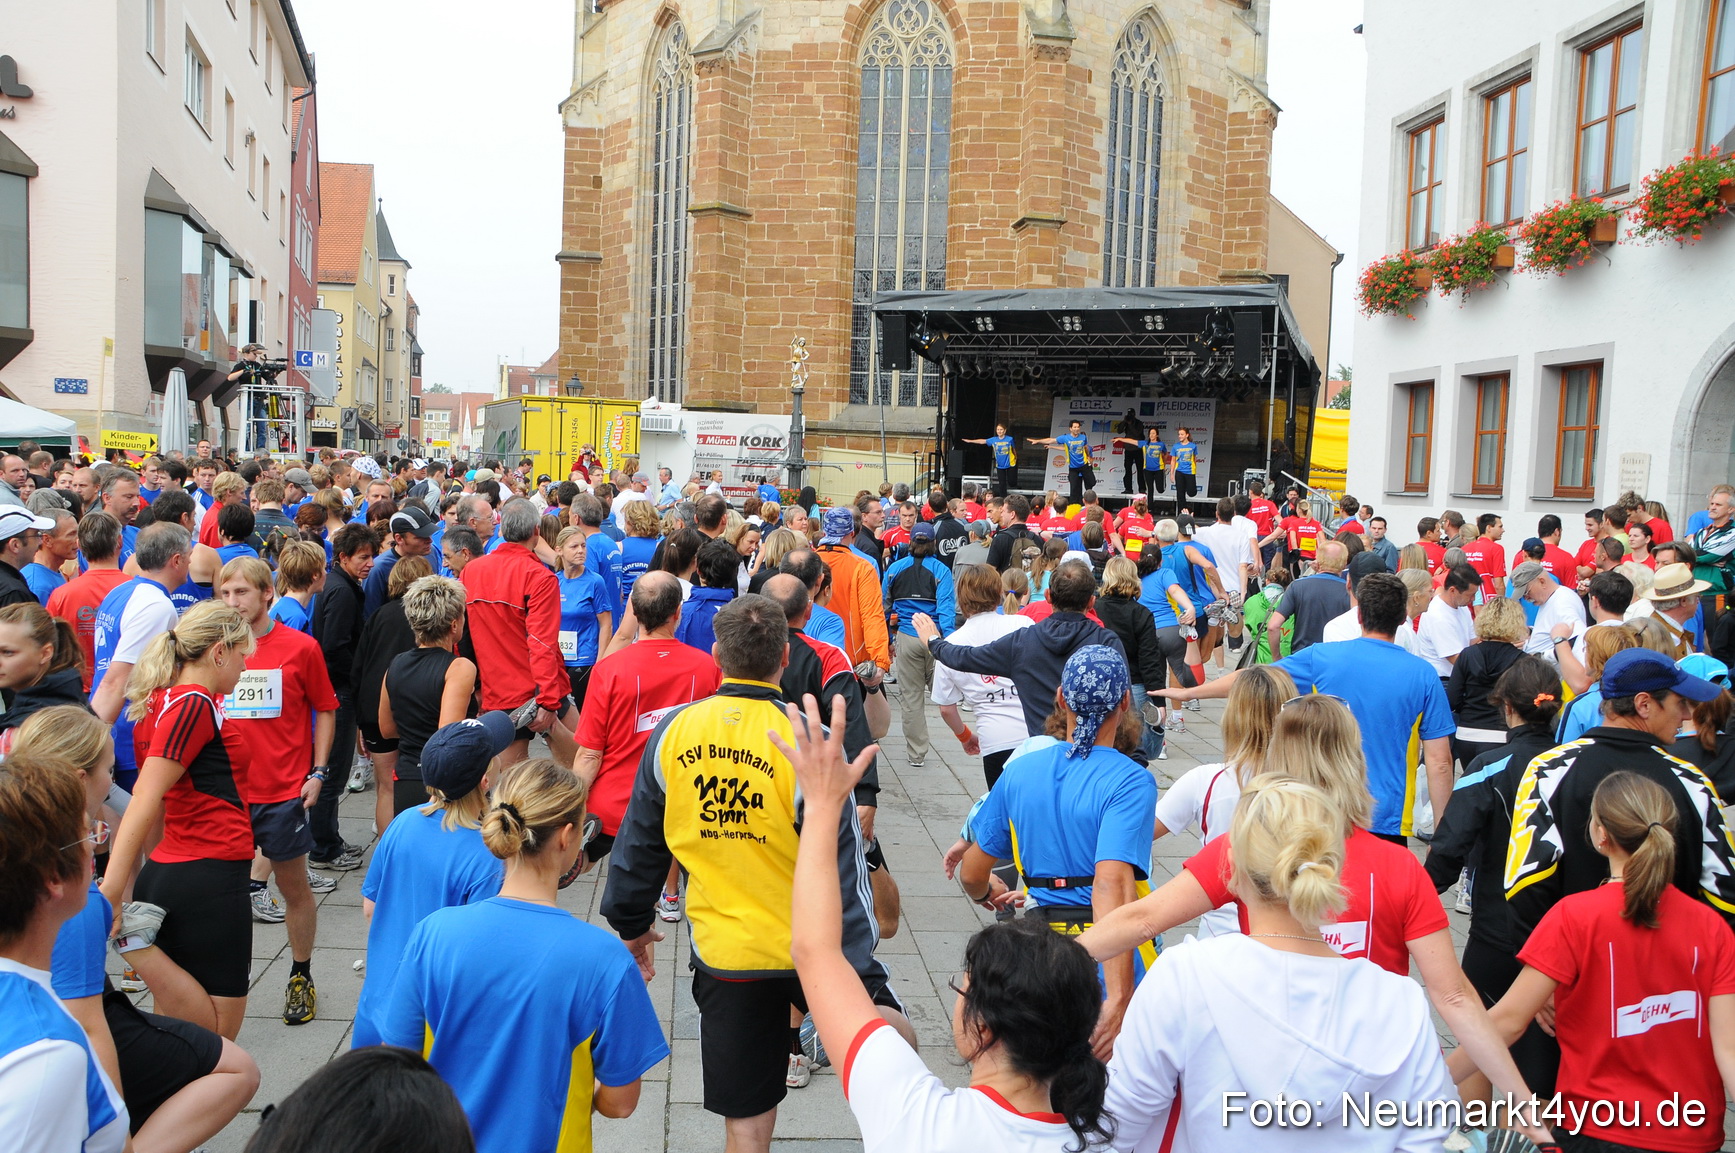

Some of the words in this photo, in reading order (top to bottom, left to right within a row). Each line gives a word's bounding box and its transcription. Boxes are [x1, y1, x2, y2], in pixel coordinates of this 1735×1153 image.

[1156, 401, 1211, 411] PFLEIDERER
[110, 432, 142, 441] Kinder-
[706, 436, 736, 446] Münch
[739, 436, 783, 448] KORK
[104, 439, 147, 451] betreuung
[170, 593, 199, 604] unner
[240, 674, 268, 683] ndreas
[238, 687, 273, 701] 2911
[676, 744, 702, 769] TSV
[709, 744, 775, 779] Burgthann
[693, 773, 764, 809] NiKa
[699, 800, 749, 828] Sport
[1641, 1002, 1671, 1024] DEHN
